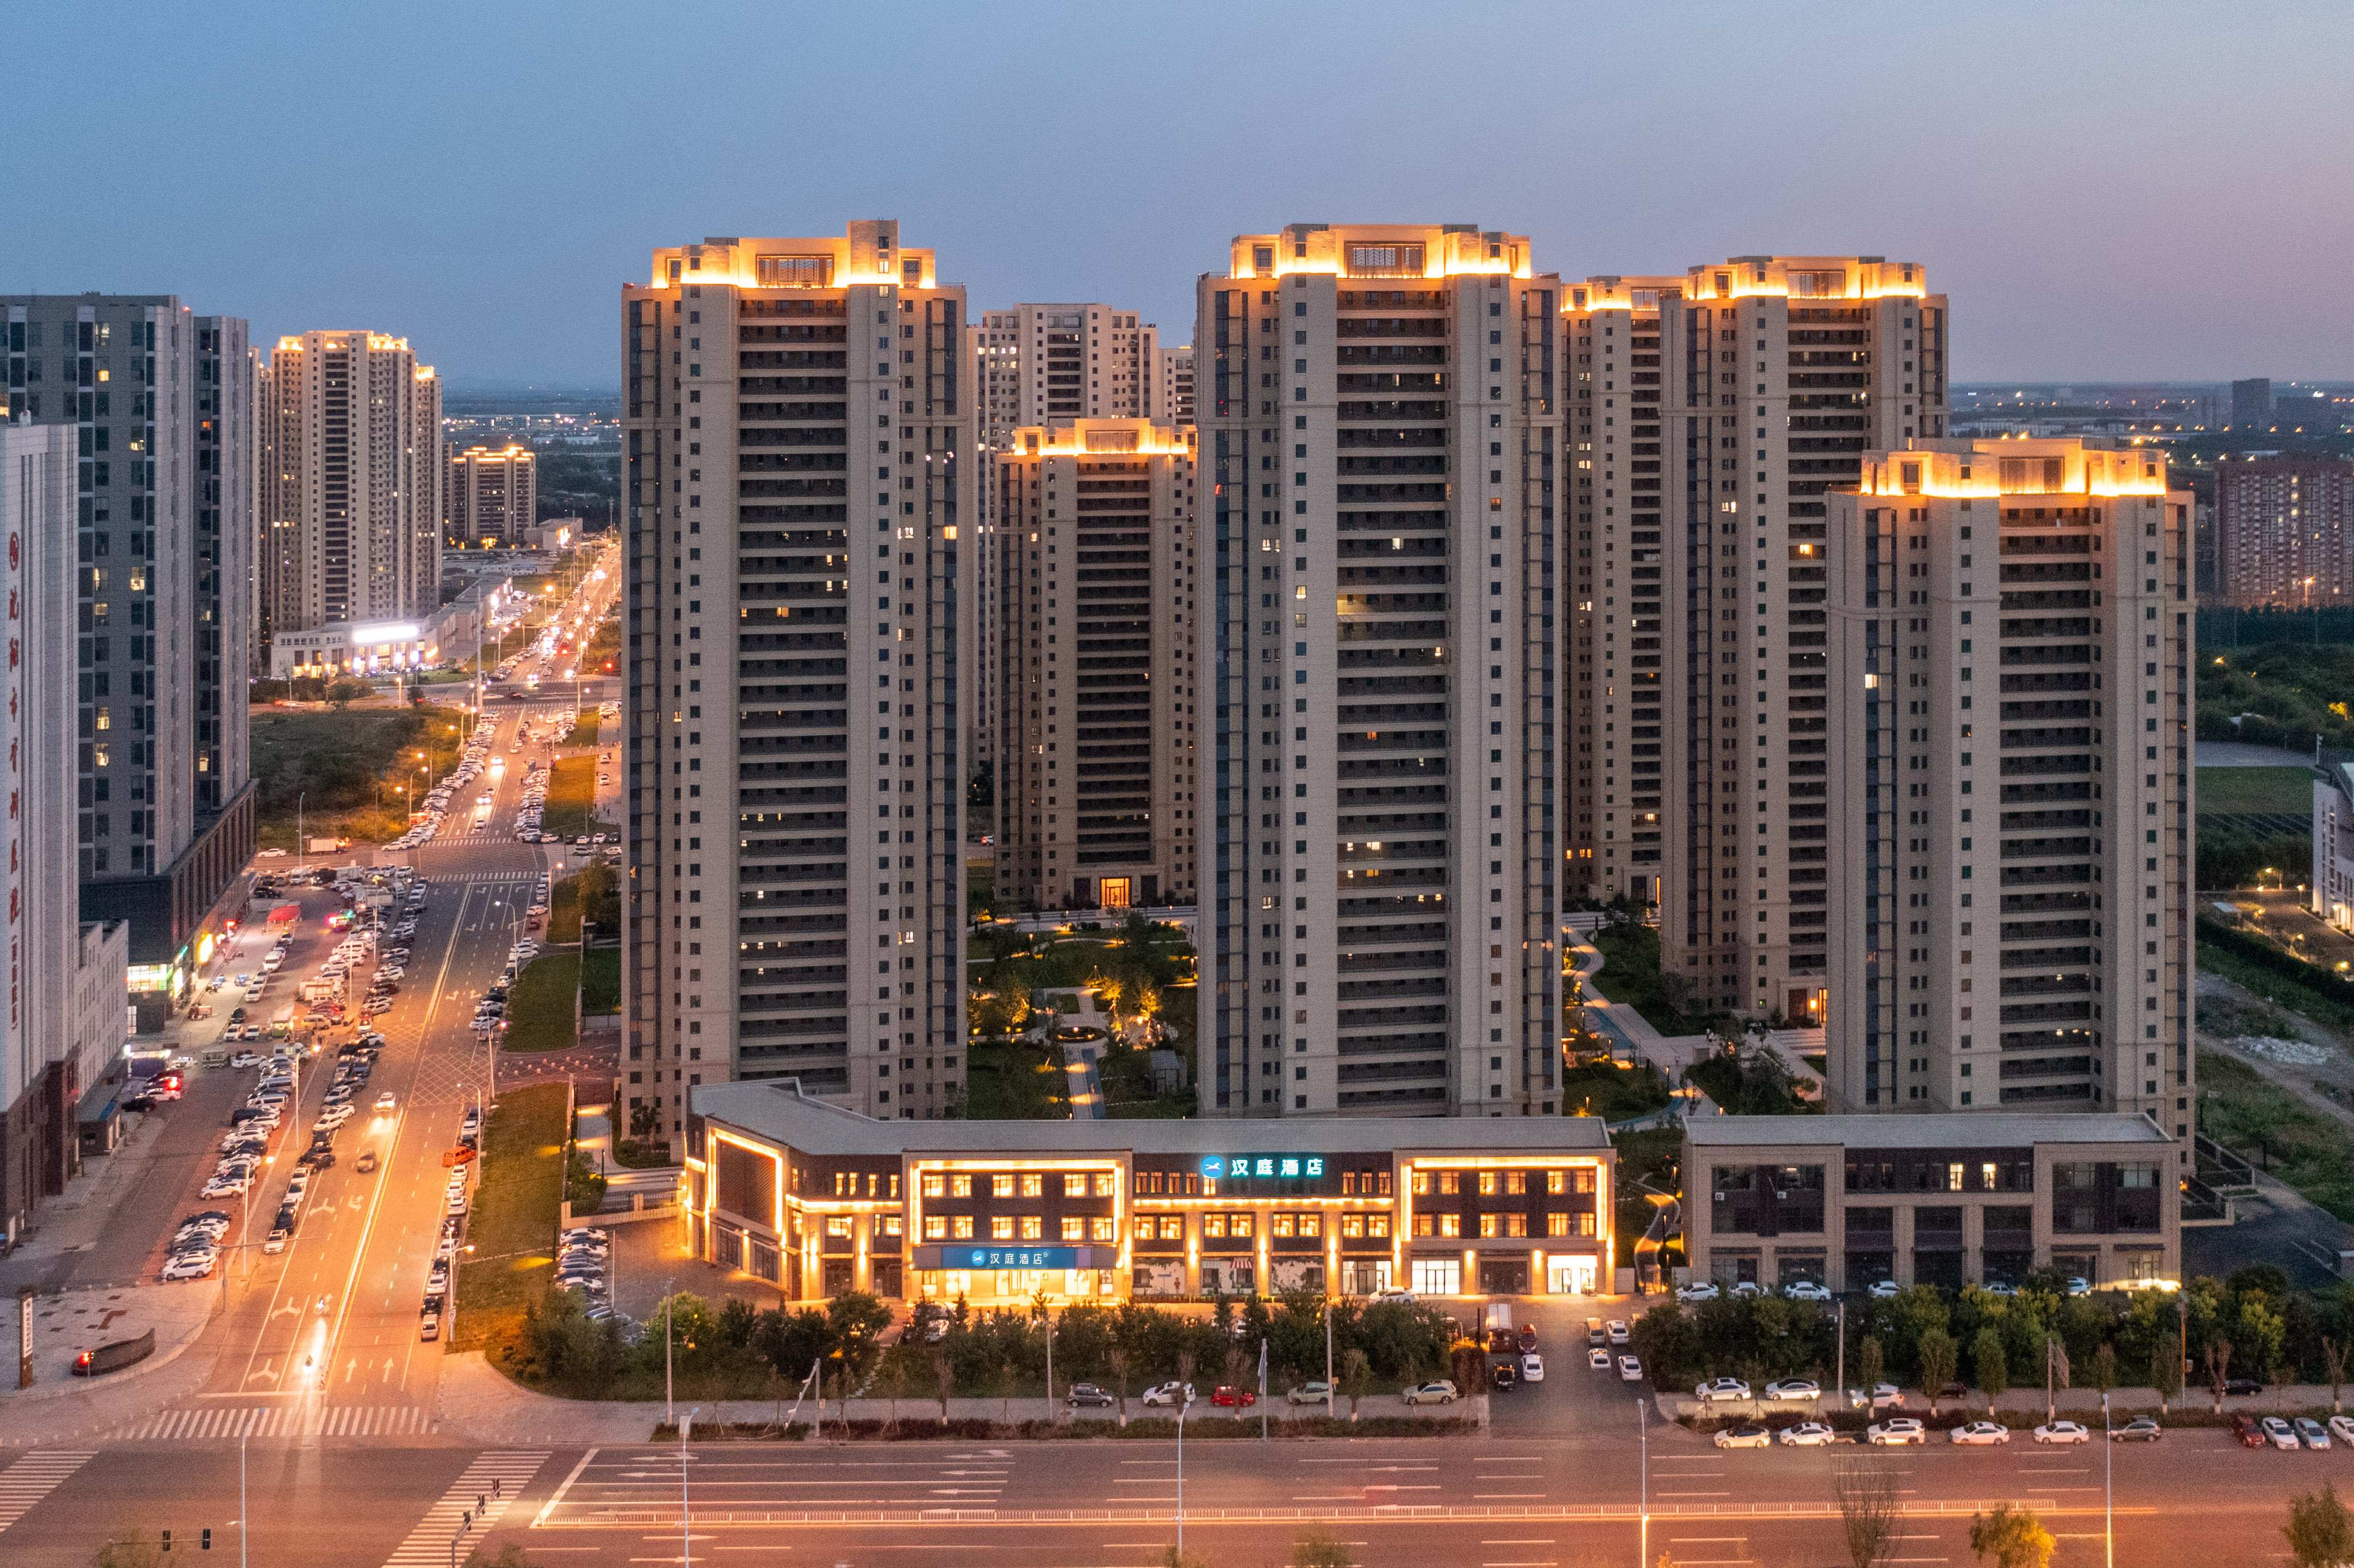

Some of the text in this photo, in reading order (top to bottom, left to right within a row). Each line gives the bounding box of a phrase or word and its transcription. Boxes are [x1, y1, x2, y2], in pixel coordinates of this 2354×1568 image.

[1231, 1159, 1323, 1175] 汉庭酒店
[990, 1253, 1042, 1264] 汉庭酒店
